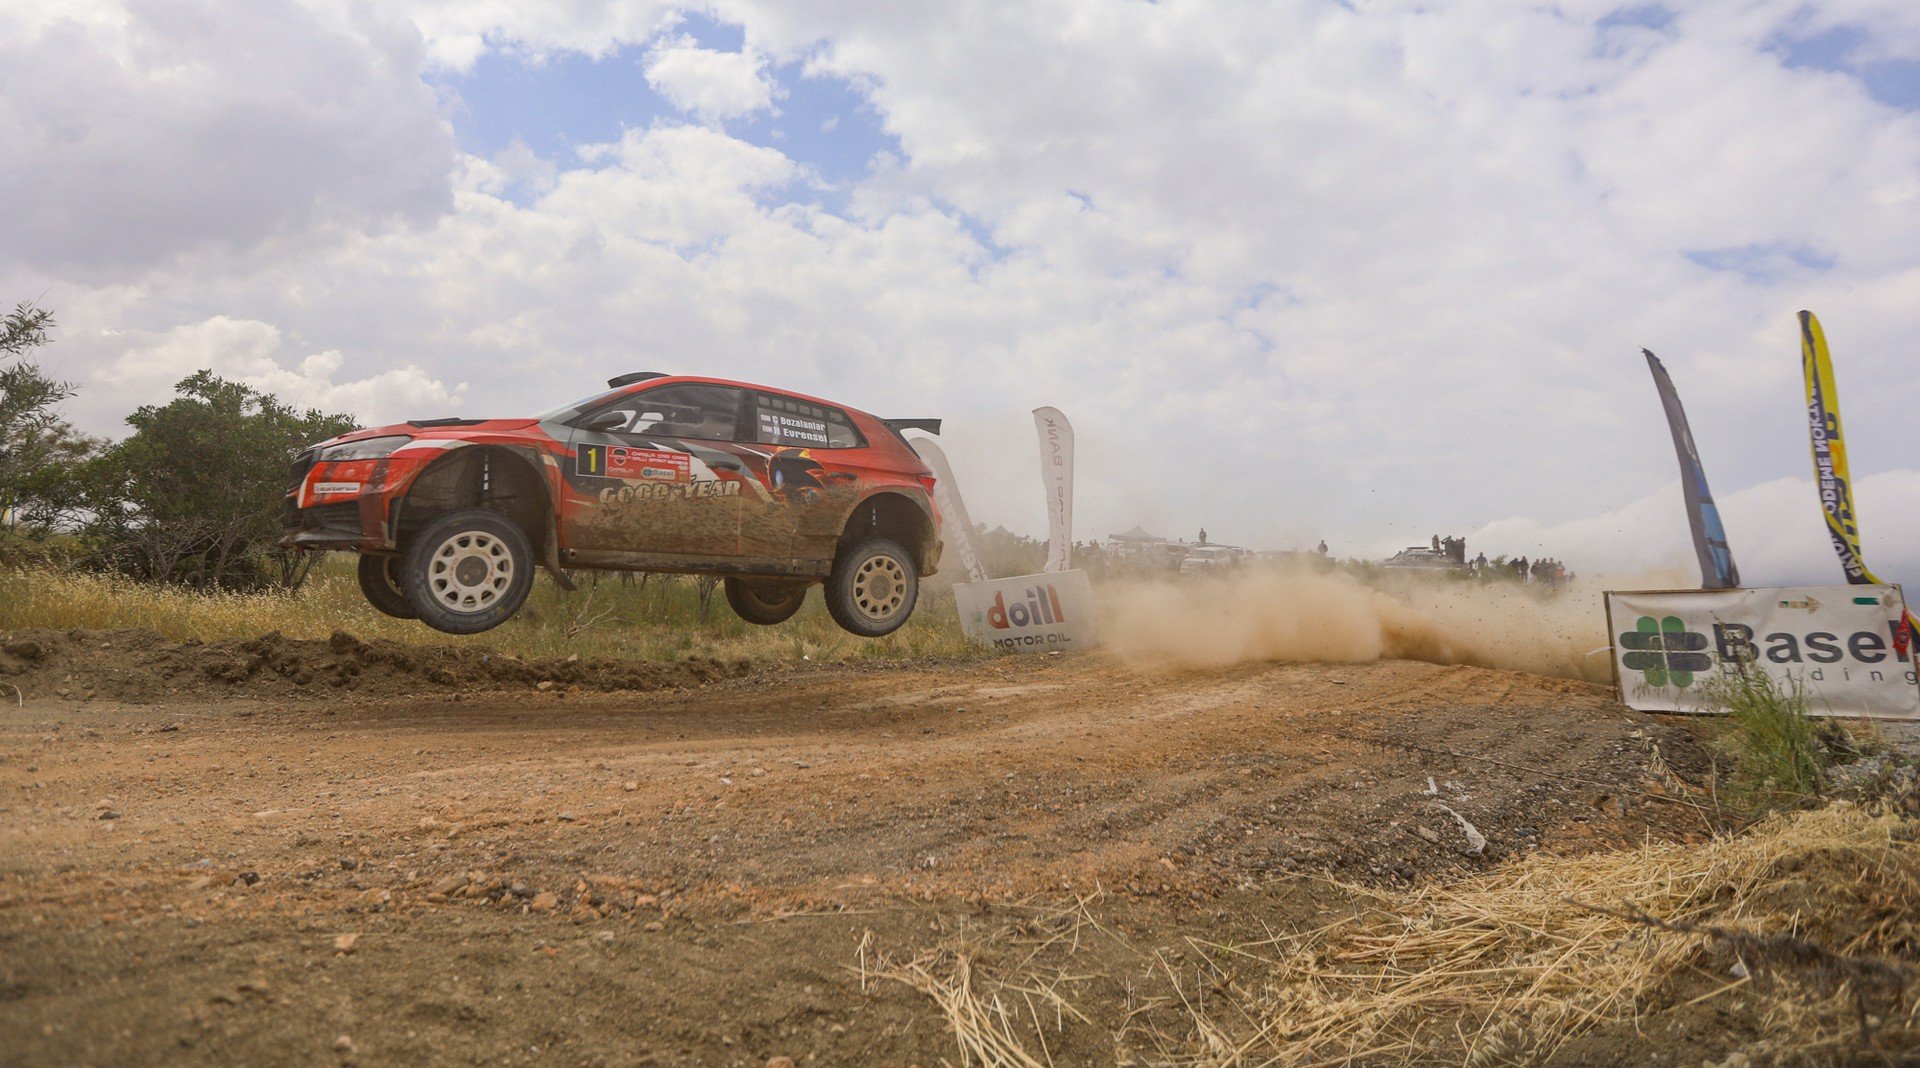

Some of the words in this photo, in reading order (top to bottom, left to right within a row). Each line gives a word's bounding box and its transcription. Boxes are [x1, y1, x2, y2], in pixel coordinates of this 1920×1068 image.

[781, 416, 826, 431] Bozalanlar
[783, 428, 828, 443] Evrensel
[587, 447, 597, 473] 1
[987, 583, 1065, 629] doill
[994, 633, 1045, 648] MOTOR
[1047, 632, 1072, 643] OIL
[1712, 619, 1911, 664] Basel
[1723, 667, 1919, 685] Hlding
